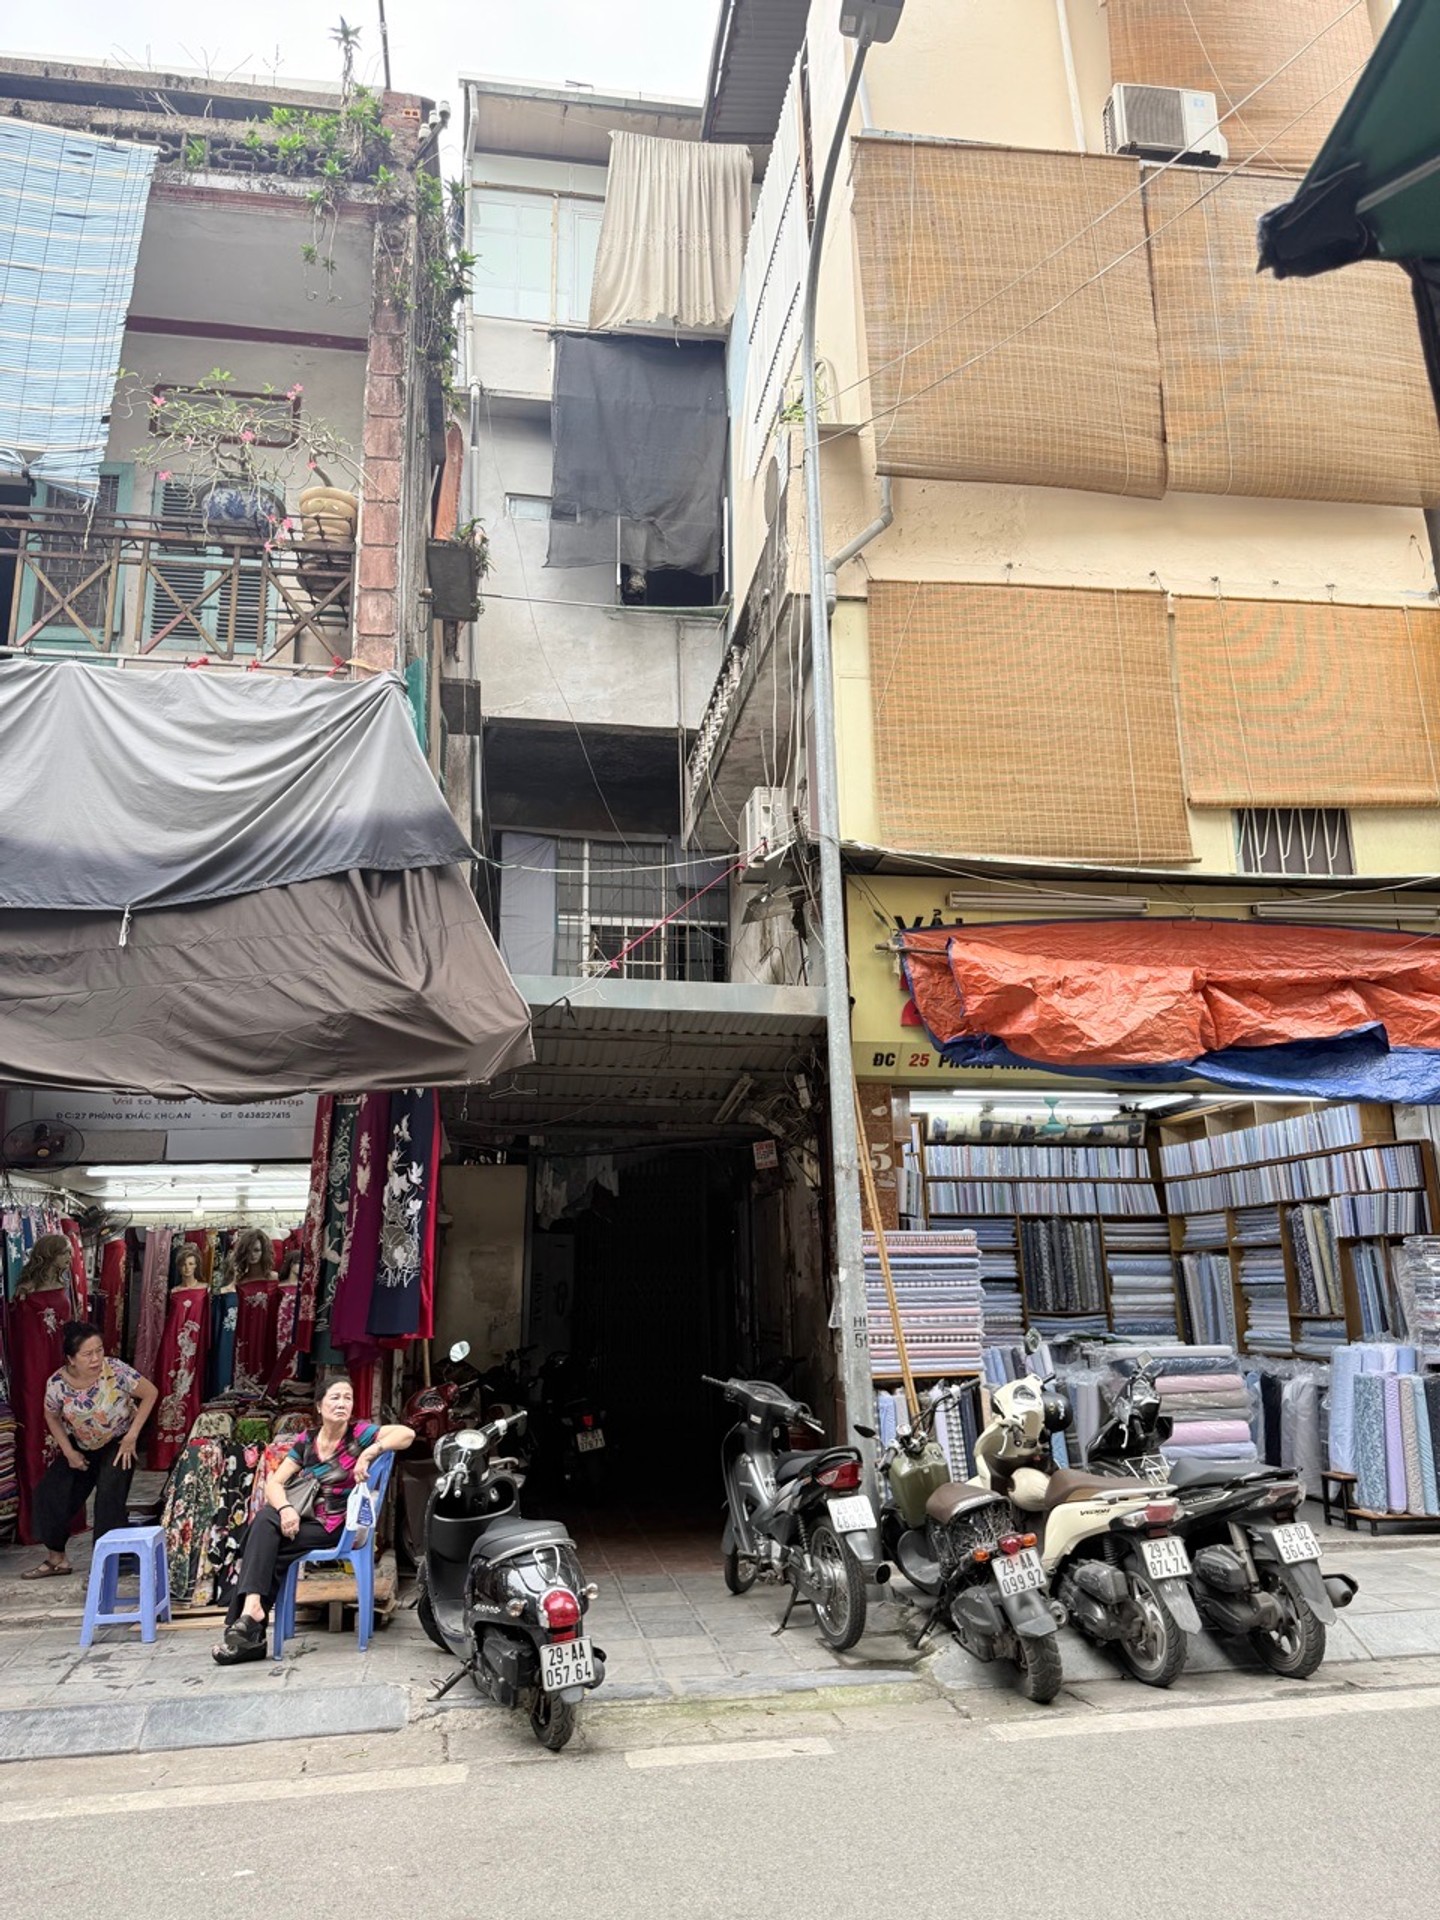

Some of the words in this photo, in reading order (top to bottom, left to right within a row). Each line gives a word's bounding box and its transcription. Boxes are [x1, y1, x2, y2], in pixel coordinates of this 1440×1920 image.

[873, 1053, 896, 1067] ĐC
[909, 1053, 930, 1067] 25
[88, 1110, 122, 1120] PHÙNG
[154, 1111, 191, 1120] KHOAN
[1147, 1540, 1179, 1559] 29-K1
[1150, 1557, 1188, 1576] 874.74
[1002, 1568, 1045, 1594] 099.92
[548, 1641, 586, 1666] 29-AA
[546, 1660, 591, 1687] 057.64
